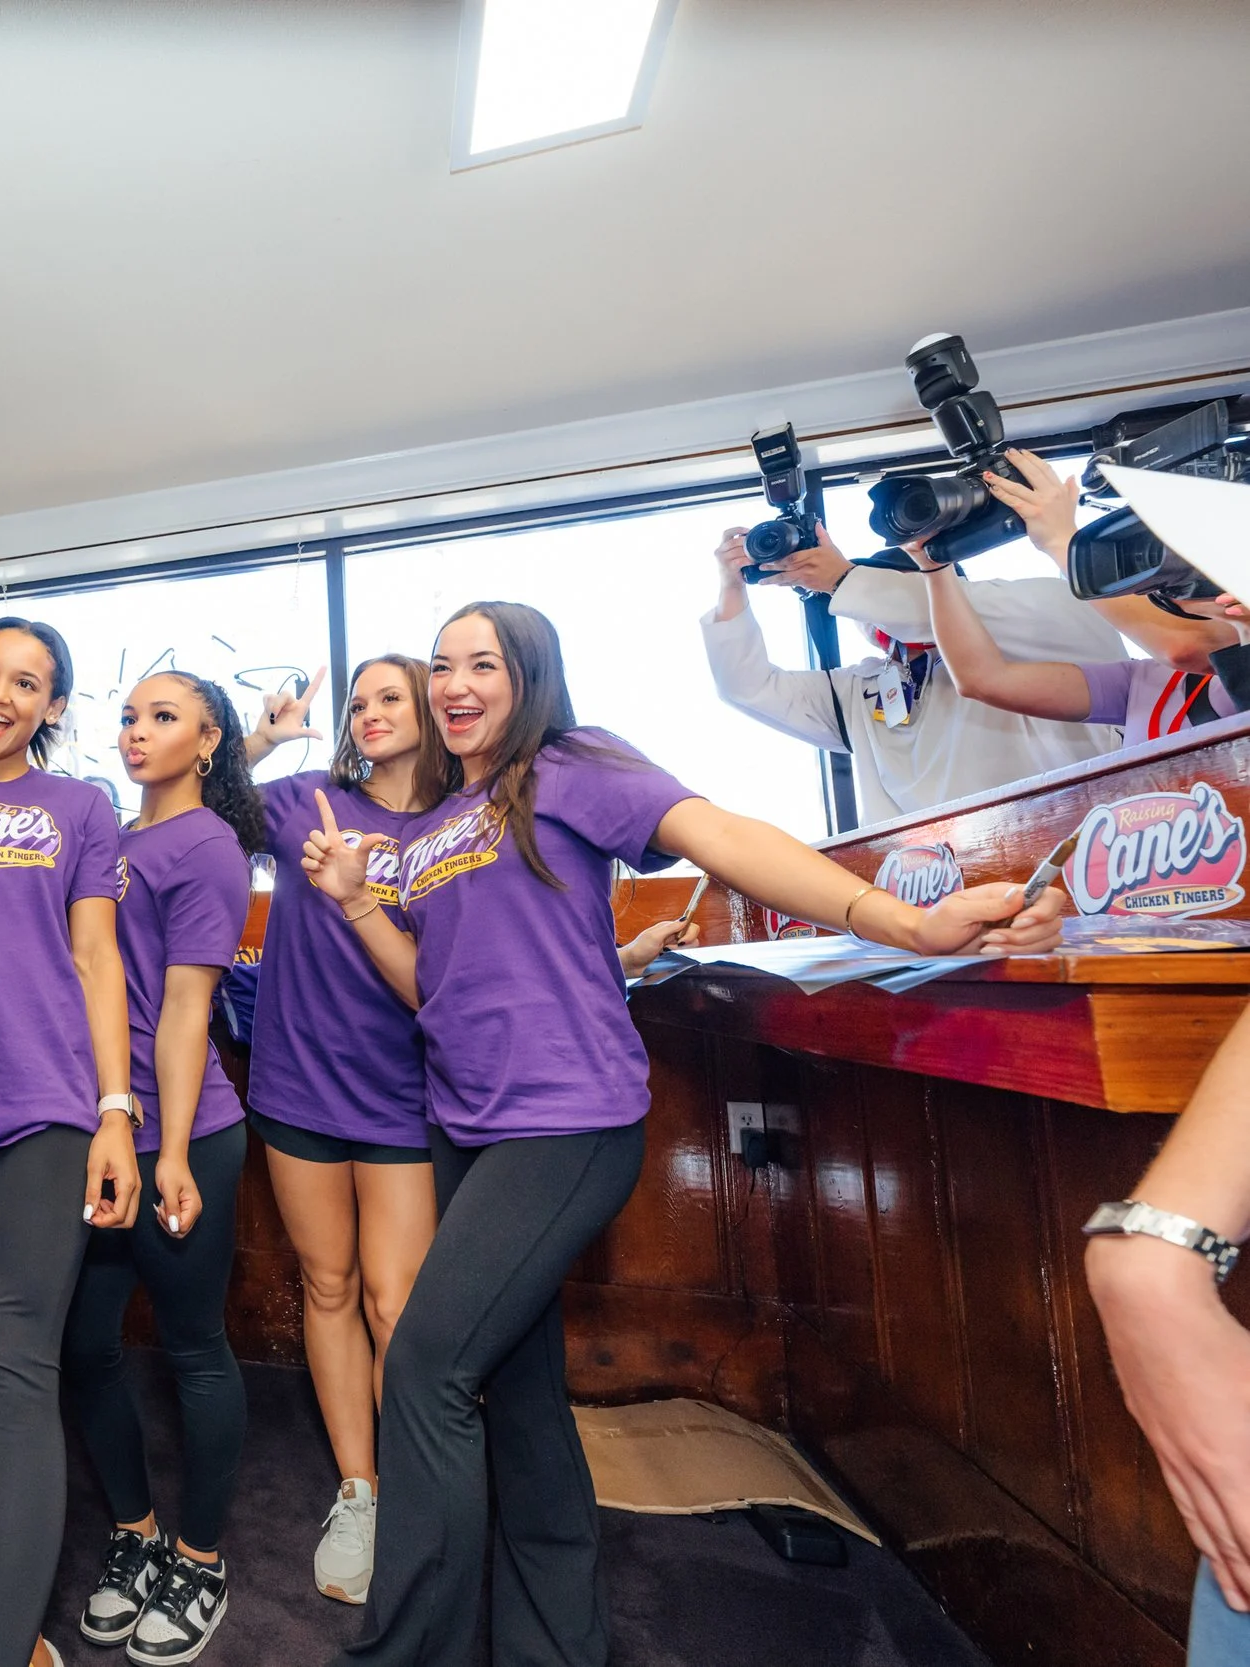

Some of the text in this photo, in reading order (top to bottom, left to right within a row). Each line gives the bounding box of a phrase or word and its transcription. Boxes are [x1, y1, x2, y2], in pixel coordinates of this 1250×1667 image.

[1118, 803, 1175, 830] Raising
[7, 850, 46, 862] FINGERS
[1073, 787, 1237, 915] Cane's
[416, 854, 482, 888] CHICKEN FINGERS
[1124, 889, 1225, 909] CHICKEN FINGERS
